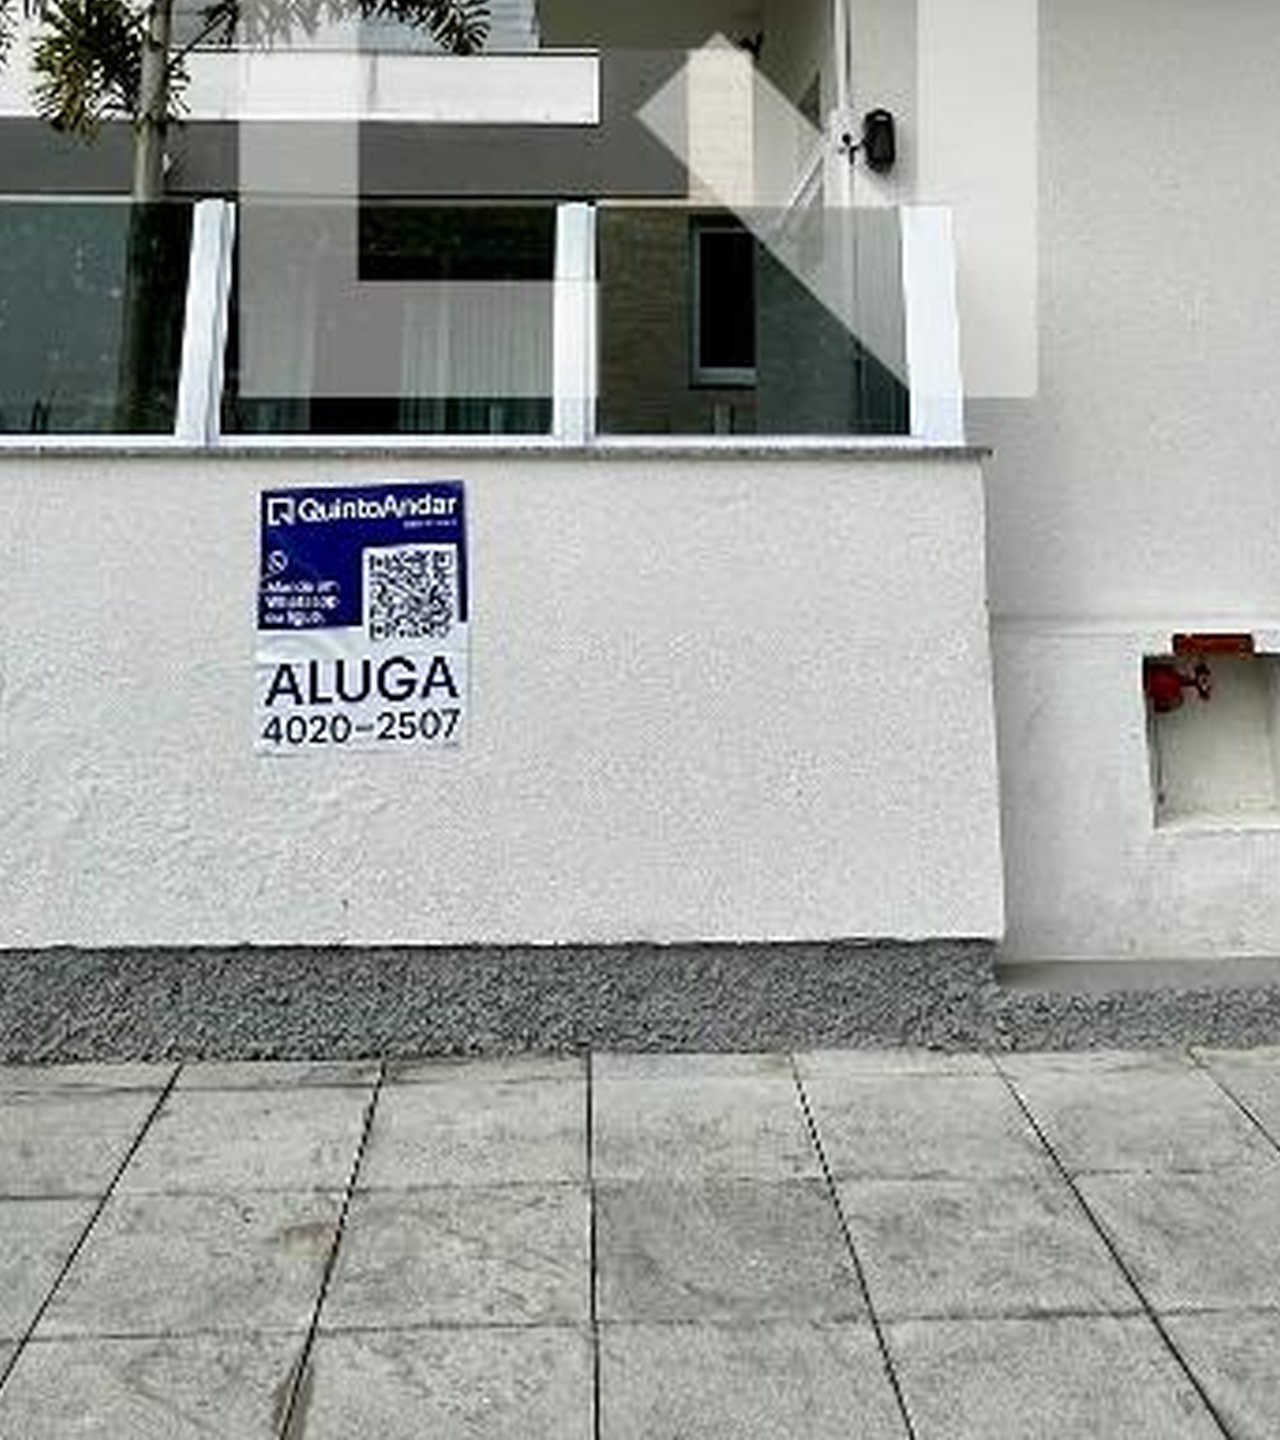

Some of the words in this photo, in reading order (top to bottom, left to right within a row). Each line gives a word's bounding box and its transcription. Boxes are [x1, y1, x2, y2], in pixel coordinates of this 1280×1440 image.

[298, 494, 457, 522] QuintoAndar
[265, 656, 460, 706] ALUGA
[262, 709, 460, 744] 4020-2507
